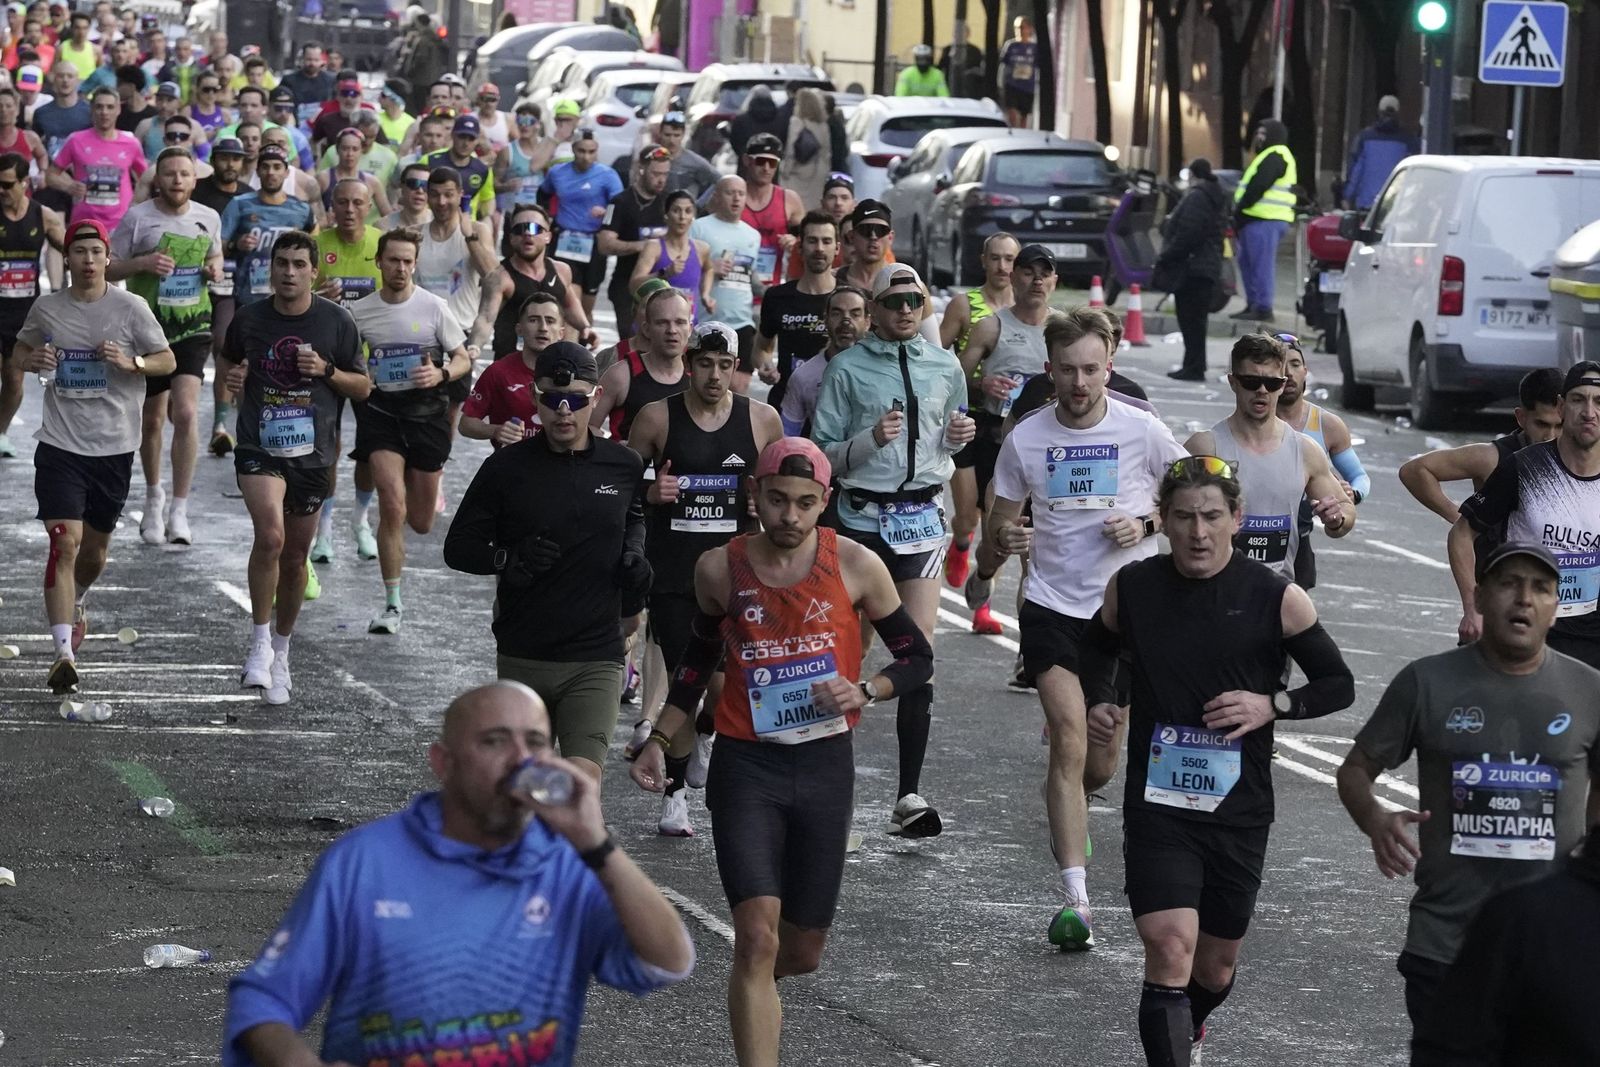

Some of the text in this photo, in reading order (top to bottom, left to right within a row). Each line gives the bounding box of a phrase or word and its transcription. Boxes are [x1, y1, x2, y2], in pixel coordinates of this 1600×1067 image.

[166, 288, 196, 297] NUGGET
[782, 313, 819, 324] Sports
[1489, 310, 1523, 323] 9177
[387, 348, 414, 357] ZURICH
[389, 371, 408, 382] BEN
[276, 408, 306, 419] ZURICH
[1070, 448, 1109, 458] ZURICH
[1071, 467, 1091, 477] 6801
[694, 478, 730, 487] ZURICH
[1069, 480, 1094, 494] NAT
[695, 495, 714, 503] 4650
[685, 506, 724, 518] PAOLO
[1248, 519, 1284, 528] ZURICH
[888, 525, 939, 544] MICHAEL
[1247, 536, 1269, 546] 4923
[1247, 549, 1267, 561] ALI
[1558, 556, 1597, 567] ZURICH
[741, 639, 836, 661] COSLADA
[777, 660, 827, 679] ZURICH
[782, 689, 809, 704] 6557
[1182, 732, 1232, 747] ZURICH
[1181, 757, 1208, 769] 5502
[1172, 771, 1216, 792] LEON
[1488, 796, 1521, 811] 4920
[1453, 813, 1556, 838] MUSTAPHA
